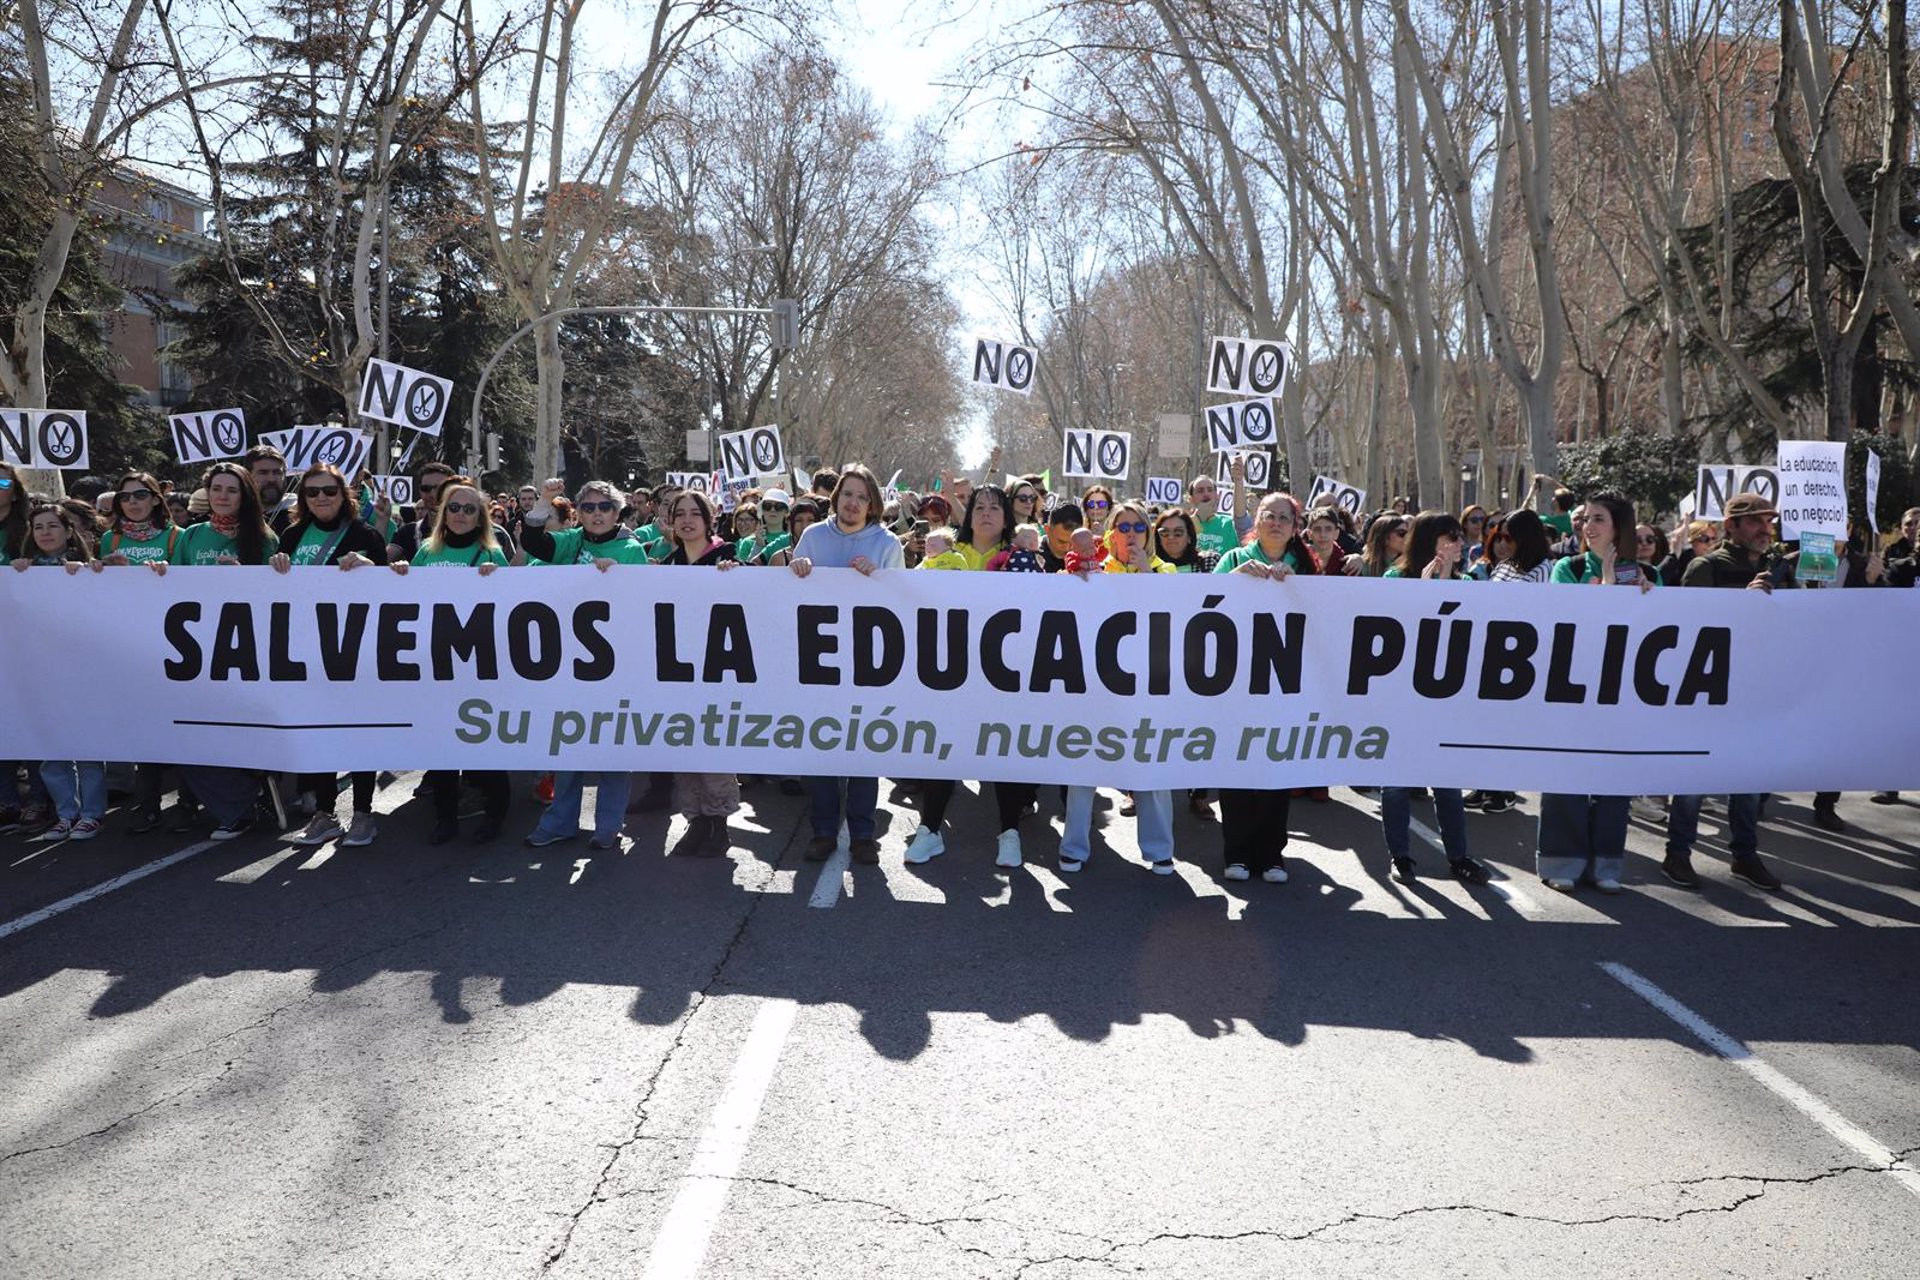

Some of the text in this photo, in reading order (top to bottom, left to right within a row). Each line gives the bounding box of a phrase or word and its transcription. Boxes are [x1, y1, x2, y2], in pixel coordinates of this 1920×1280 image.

[973, 340, 1033, 390] NO
[1210, 340, 1284, 394] NO
[362, 363, 444, 428] NO
[0, 413, 83, 466] NO
[174, 413, 244, 461] NO
[1208, 402, 1272, 449] NO
[722, 429, 779, 479] NO
[1066, 432, 1127, 475] NO
[1780, 456, 1791, 472] La
[1148, 480, 1179, 501] NO
[1699, 469, 1779, 516] NO
[1785, 484, 1798, 496] un
[1784, 506, 1844, 524] no negocio!
[163, 595, 1731, 707] SALVEMOS LA EDUCACIÓN PÚBLICA
[455, 698, 1390, 763] Su privatización, nuestra ruina
